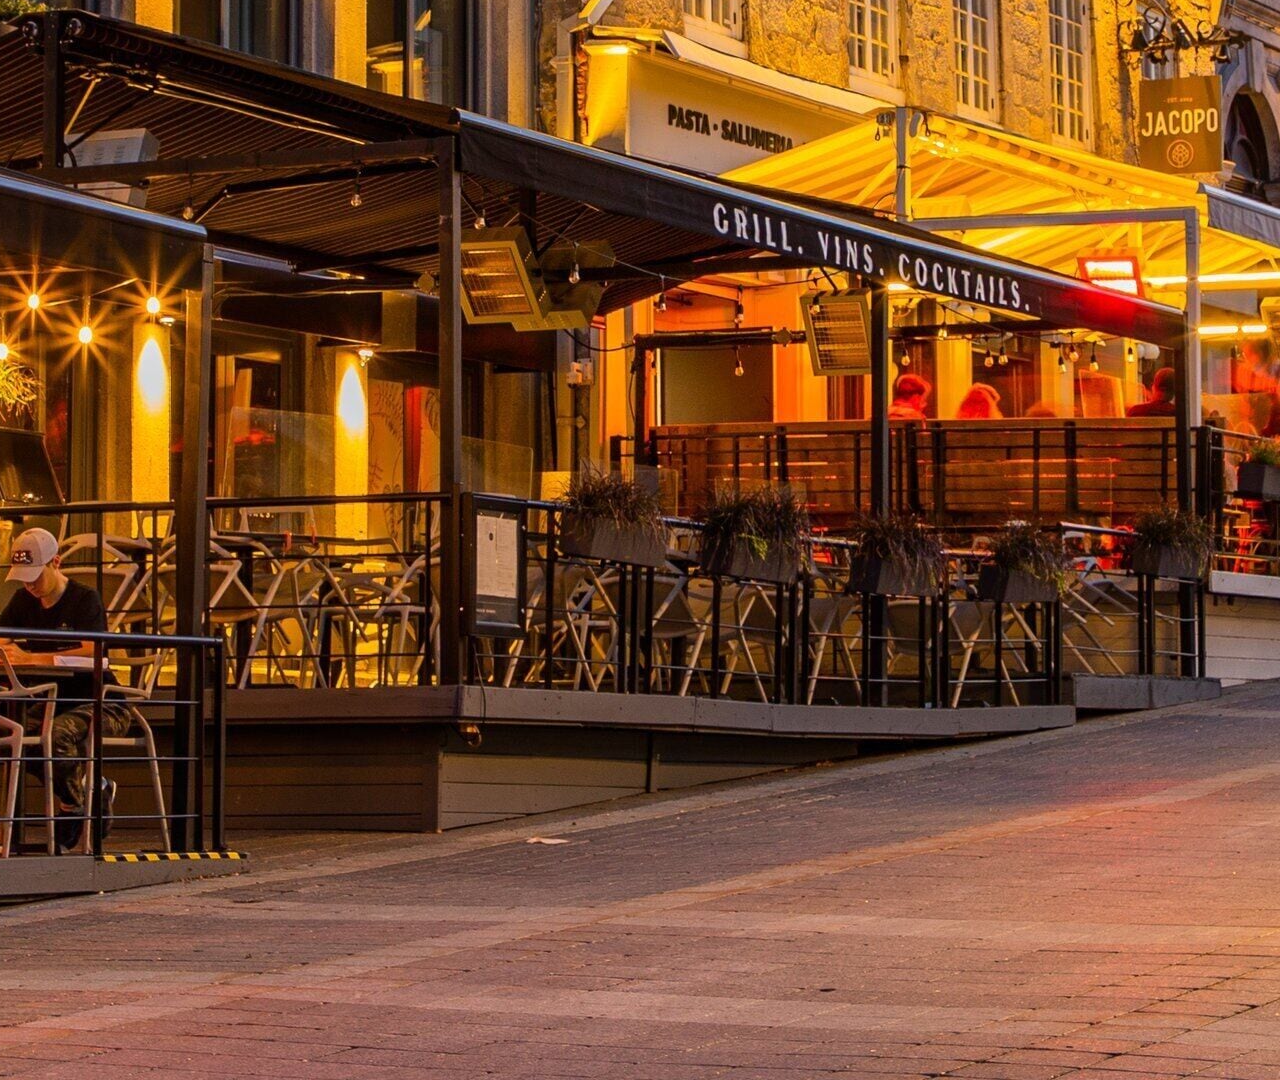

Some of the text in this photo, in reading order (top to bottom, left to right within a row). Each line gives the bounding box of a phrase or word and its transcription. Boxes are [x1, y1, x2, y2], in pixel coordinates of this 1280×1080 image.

[667, 104, 793, 153] PASTA SALUMERIA
[1141, 107, 1218, 137] JACOPO
[713, 202, 1031, 311] GRILL. VINS. COCKTAILS.
